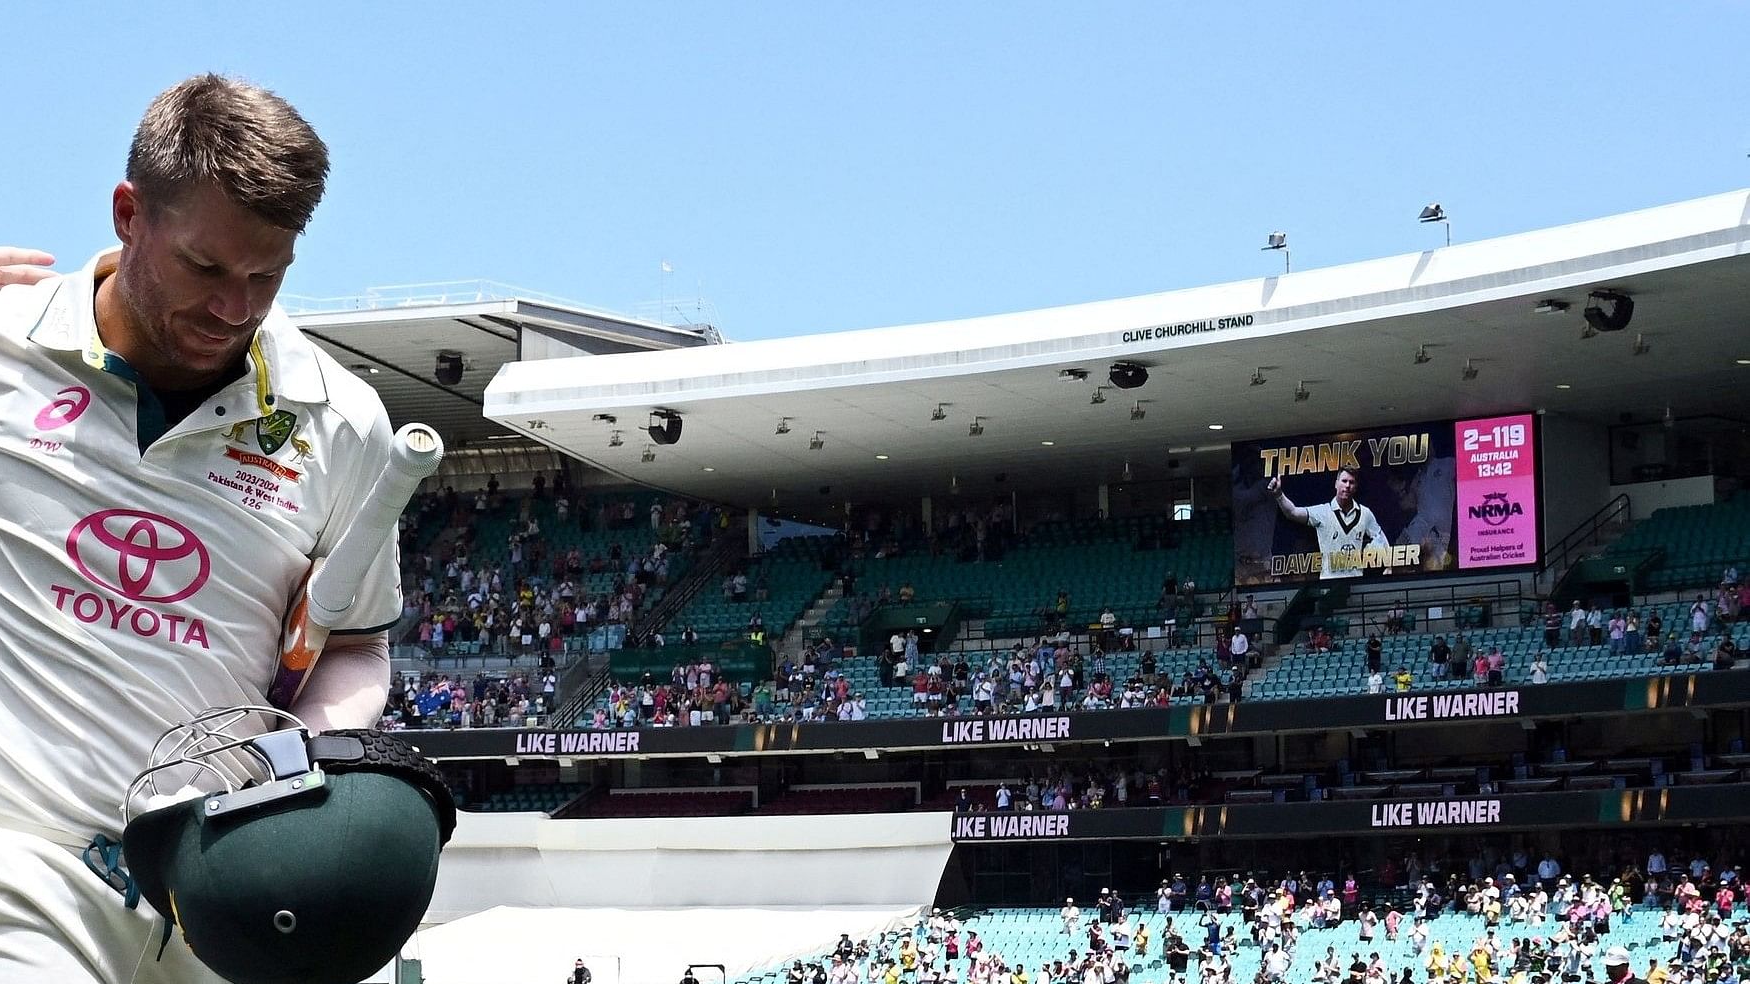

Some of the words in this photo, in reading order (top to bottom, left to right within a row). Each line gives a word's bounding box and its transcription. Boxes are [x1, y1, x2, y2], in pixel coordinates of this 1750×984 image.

[1122, 329, 1152, 342] CLIVE
[1154, 320, 1216, 338] CHURCHILL
[1218, 315, 1254, 330] STAND
[1464, 424, 1525, 451] 2-119
[242, 454, 284, 476] AUSTRALIA
[1260, 439, 1362, 478] THANK
[1368, 432, 1430, 467] YOU
[1470, 450, 1519, 463] AUSTRALIA
[235, 470, 280, 492] 2023/2024
[1478, 462, 1512, 478] 13:42
[208, 472, 244, 492] Pakistan
[244, 486, 254, 496] &
[255, 488, 275, 504] West
[276, 497, 300, 514] Indies
[242, 496, 263, 510] 426
[1468, 502, 1524, 519] NRMA
[1478, 528, 1514, 536] INSURANCE
[1270, 551, 1324, 576] DAVE
[1328, 544, 1420, 572] WARNER
[50, 584, 210, 650] TOYOTA
[1385, 697, 1428, 720] LIKE
[1432, 692, 1519, 718] WARNER
[942, 720, 984, 742] LIKE
[988, 717, 1070, 741] WARNER
[516, 734, 556, 753] LIKE
[560, 732, 640, 752] WARNER
[1372, 803, 1412, 826] LIKE
[1417, 800, 1500, 825] WARNER
[952, 816, 986, 838] IKE
[990, 815, 1069, 836] WARNER
